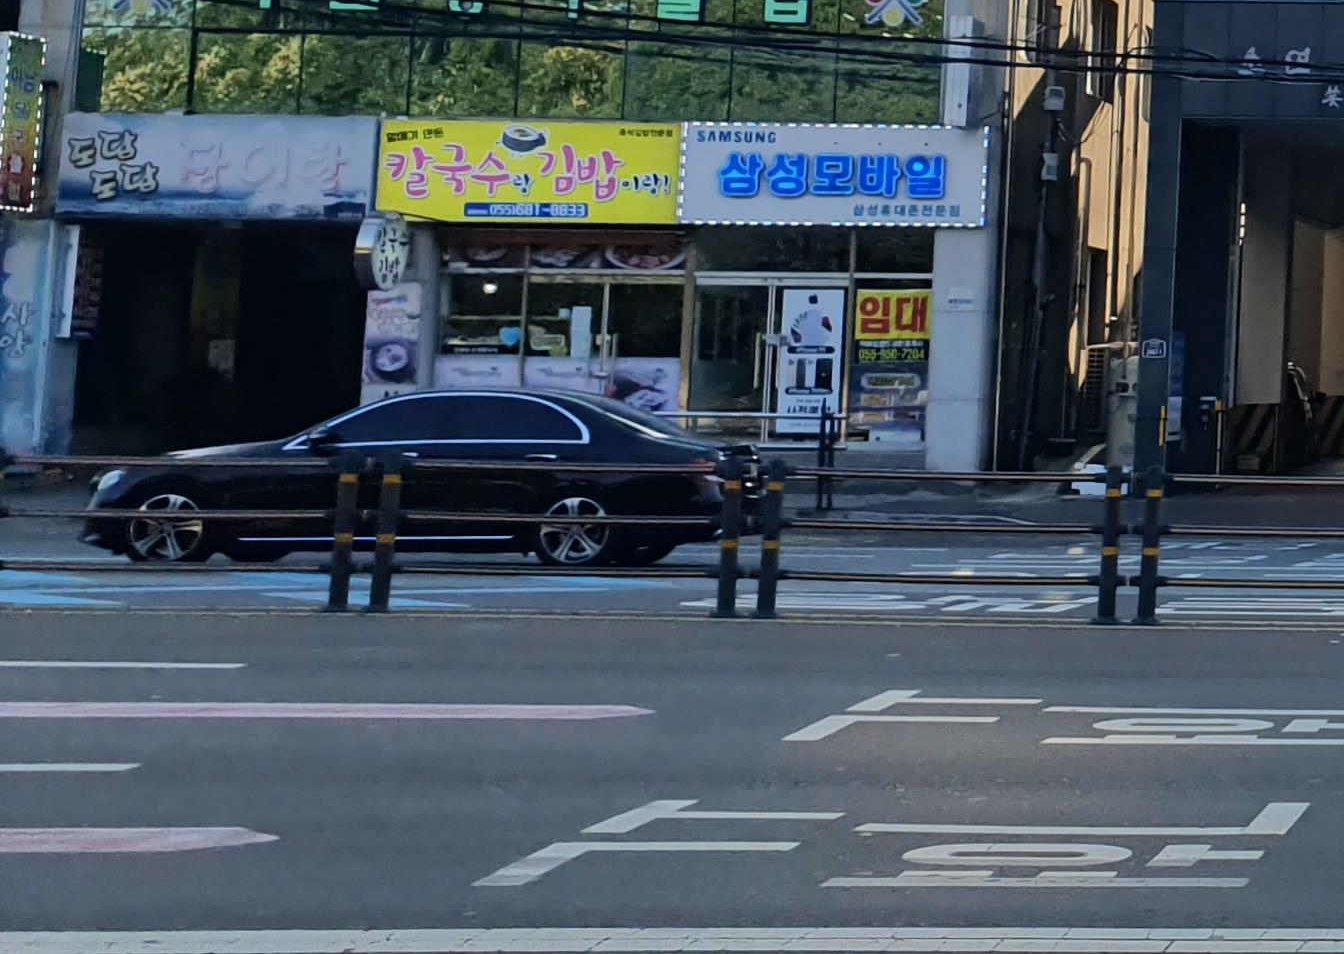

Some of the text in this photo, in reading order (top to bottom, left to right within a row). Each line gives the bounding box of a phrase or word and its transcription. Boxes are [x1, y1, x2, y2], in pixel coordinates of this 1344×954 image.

[696, 129, 777, 144] SAMSUNG
[384, 144, 671, 202] 칼국수랑 김밥이랑!
[717, 151, 948, 200] 삼성모바일
[858, 295, 930, 335] 임대
